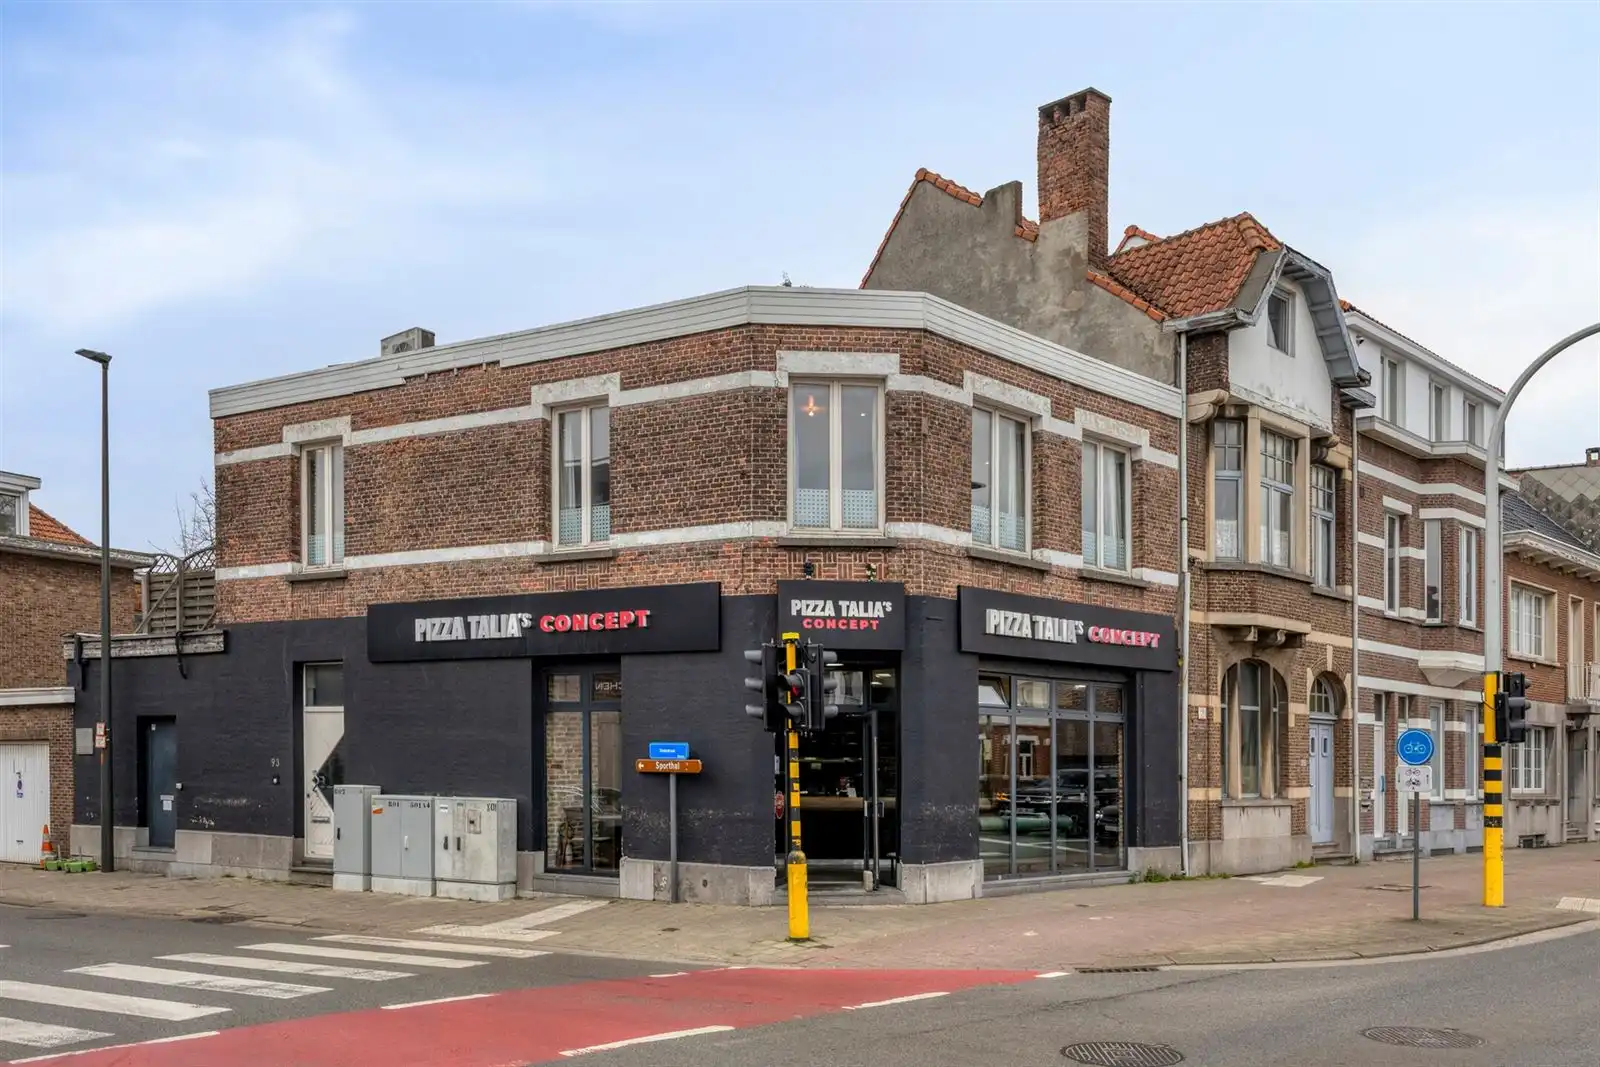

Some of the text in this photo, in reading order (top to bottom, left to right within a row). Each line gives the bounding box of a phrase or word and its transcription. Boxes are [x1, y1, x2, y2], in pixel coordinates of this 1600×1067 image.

[790, 599, 835, 616] PIZZA
[415, 616, 467, 642] PIZZA
[539, 609, 651, 633] CONCEPT
[802, 618, 880, 630] CONCEPT
[985, 608, 1032, 639] PIZZA
[1087, 625, 1160, 648] CONCEPT
[271, 758, 280, 768] 93
[655, 761, 680, 772] Sporthal
